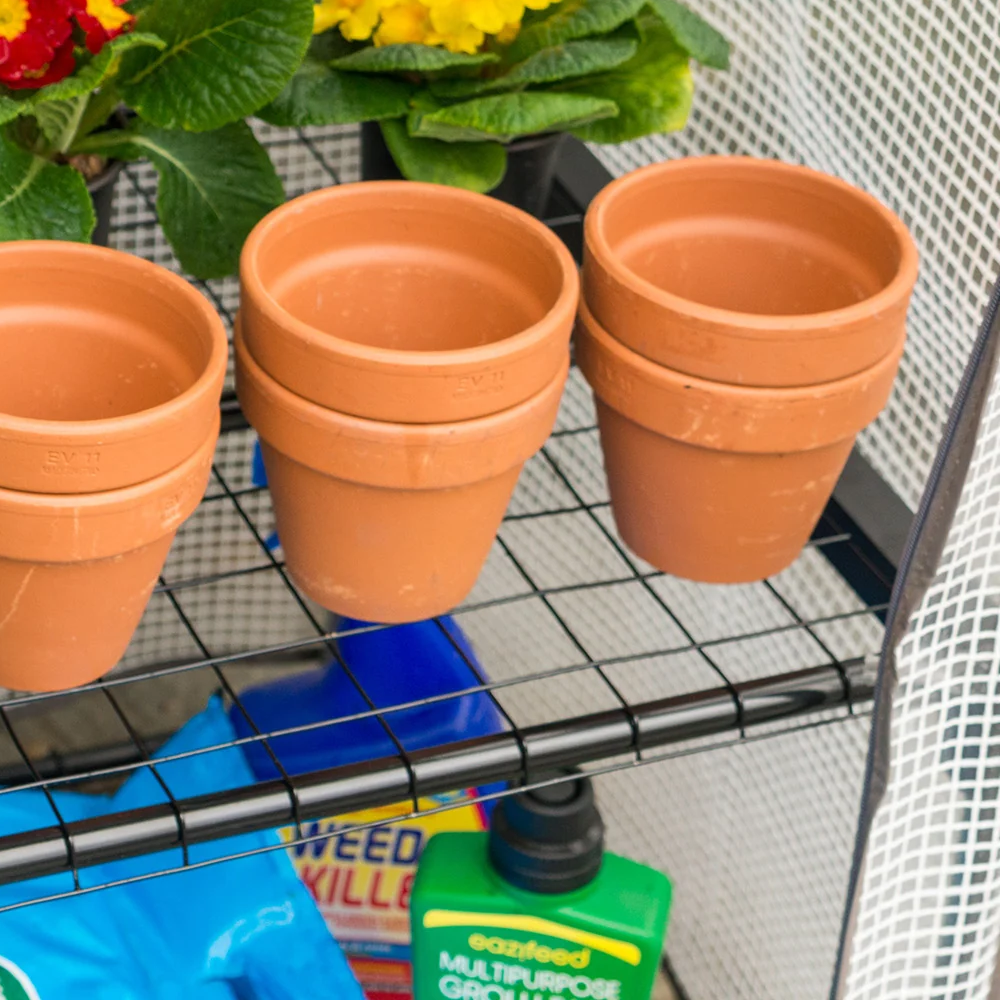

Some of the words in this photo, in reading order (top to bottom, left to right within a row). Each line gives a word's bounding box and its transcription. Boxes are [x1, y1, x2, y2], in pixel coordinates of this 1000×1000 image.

[294, 822, 423, 866] WEED
[301, 864, 415, 909] KILLE
[439, 951, 622, 1000] MULTIPURPOSE
